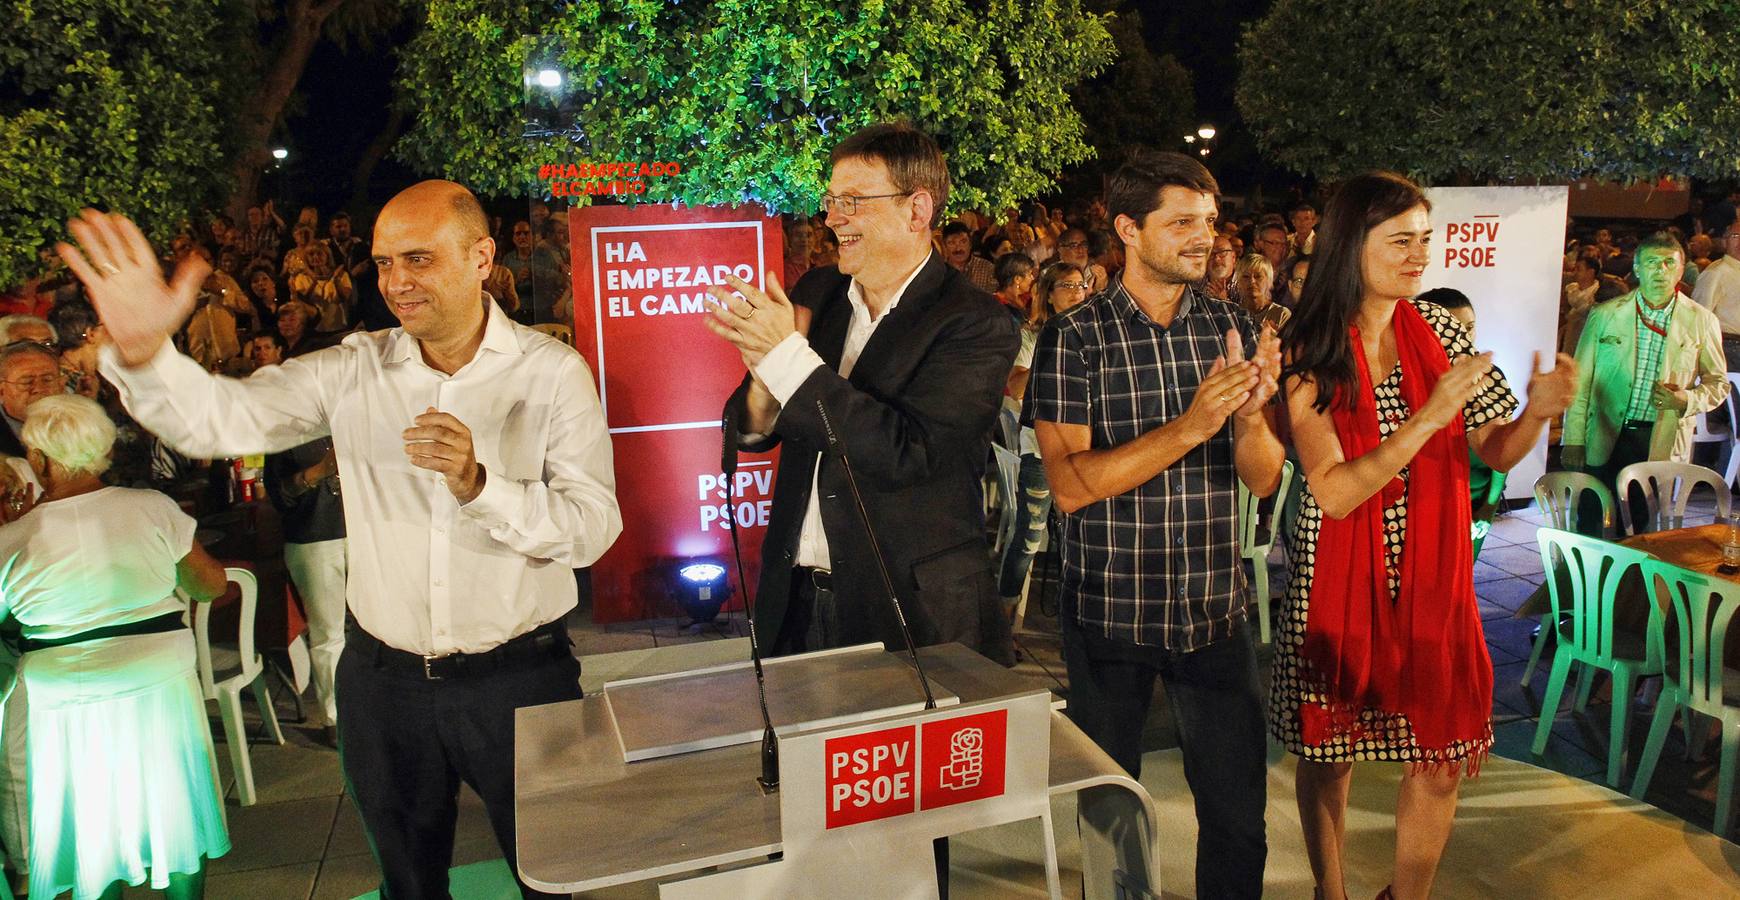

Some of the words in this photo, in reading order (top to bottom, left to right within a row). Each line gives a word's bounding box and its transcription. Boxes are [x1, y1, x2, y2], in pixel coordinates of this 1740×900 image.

[1446, 222, 1500, 243] PSPV
[605, 241, 647, 263] HA
[1445, 246, 1496, 268] PSOE
[606, 263, 754, 290] EMPEZADO
[608, 297, 635, 318] EL
[698, 469, 773, 501] PSPV
[700, 500, 772, 532] PSOE
[832, 741, 909, 779] PSPV
[833, 771, 910, 812] PSOE
